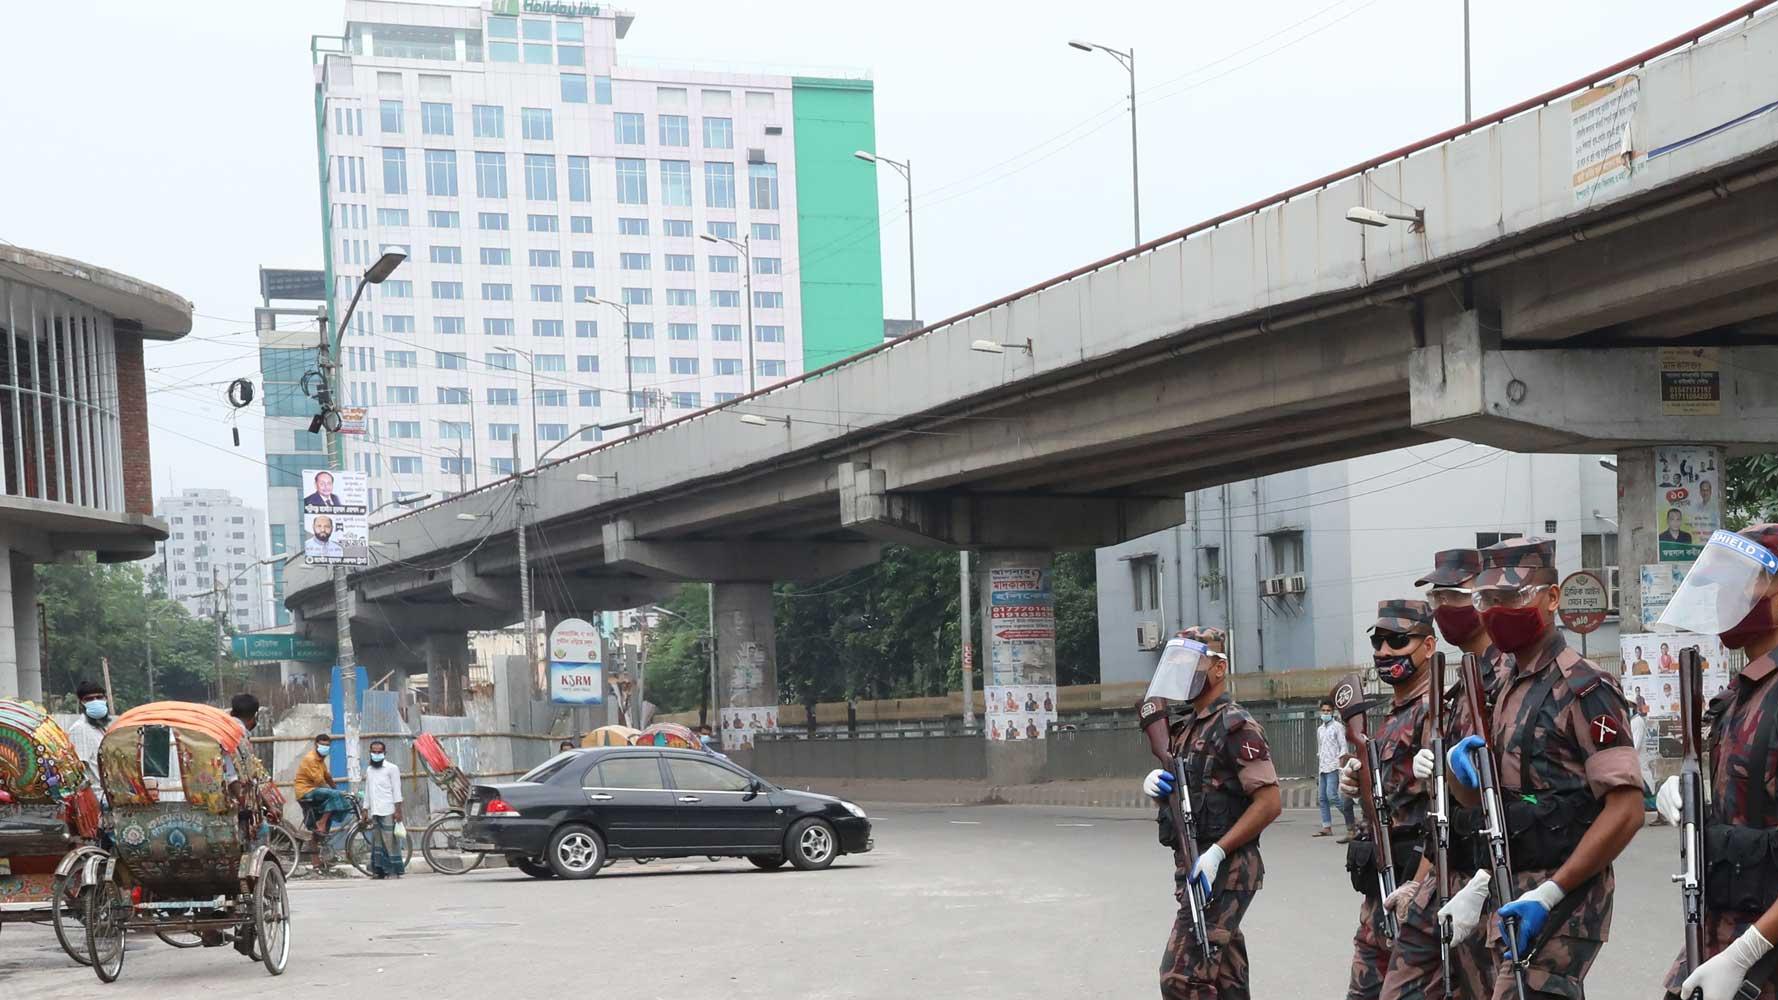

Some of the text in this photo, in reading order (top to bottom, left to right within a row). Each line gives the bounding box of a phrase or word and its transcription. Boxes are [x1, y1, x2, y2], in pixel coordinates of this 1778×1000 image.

[523, 0, 600, 17] Holiday Inn
[1711, 533, 1756, 554] SHIELD
